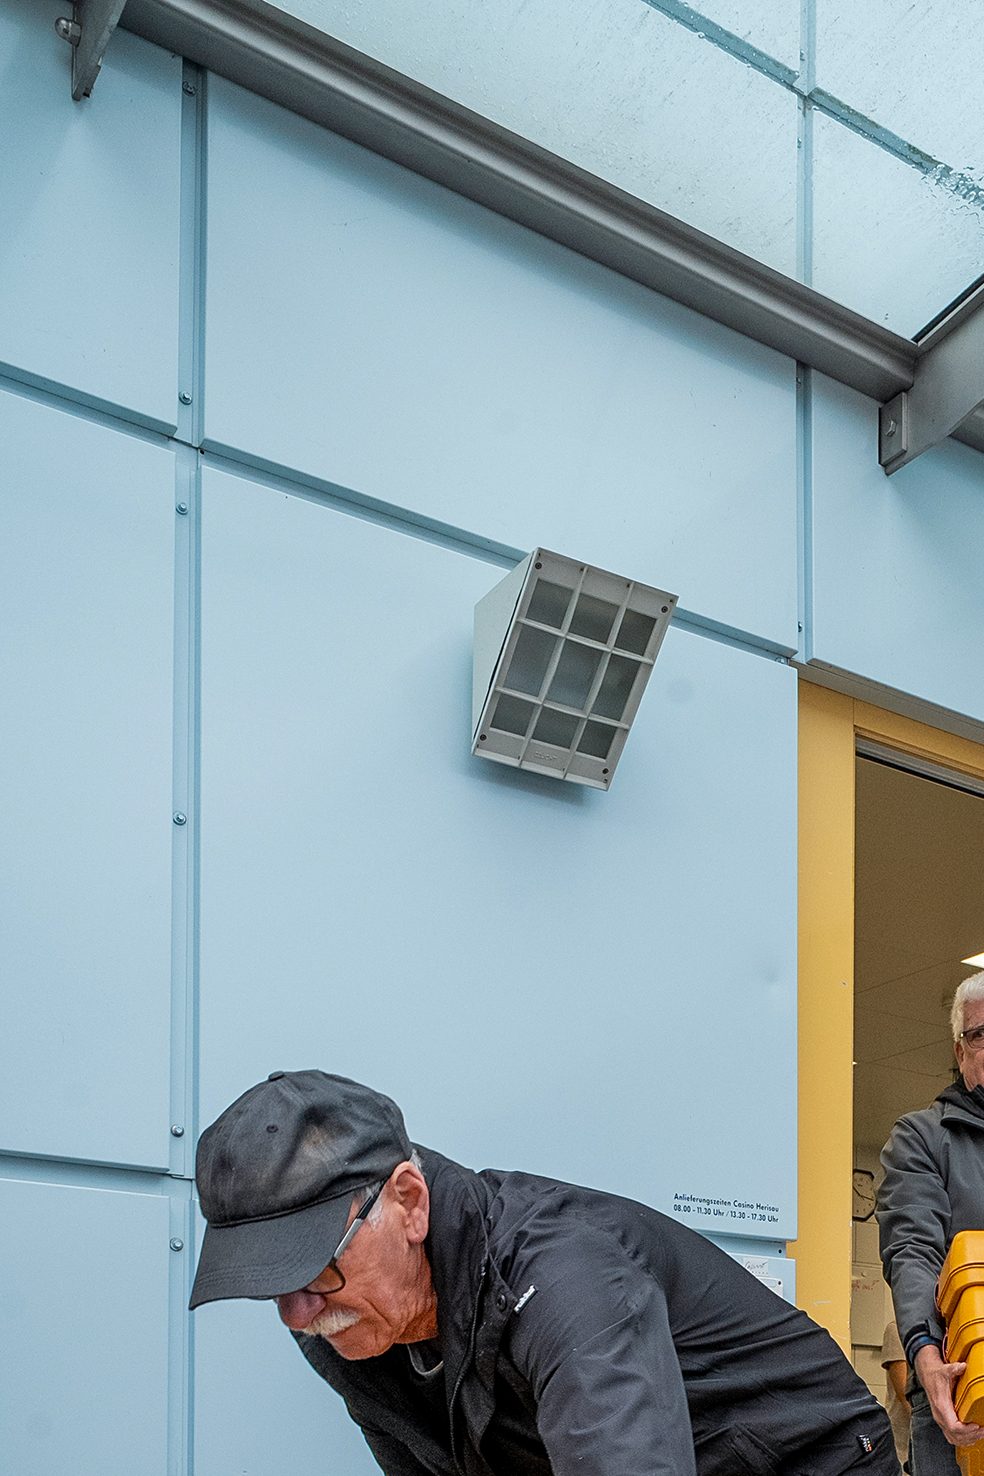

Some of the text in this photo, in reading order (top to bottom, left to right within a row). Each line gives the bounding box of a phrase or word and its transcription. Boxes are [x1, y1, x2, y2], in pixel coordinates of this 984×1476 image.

[673, 1193, 780, 1213] Anlieferungszeiten Casino Herisau
[673, 1204, 691, 1213] 08.00
[697, 1207, 712, 1215] 11.30
[713, 1208, 725, 1217] Uhr
[730, 1210, 746, 1219] 13.30
[751, 1213, 767, 1221] 17.30
[767, 1215, 779, 1223] Uhr
